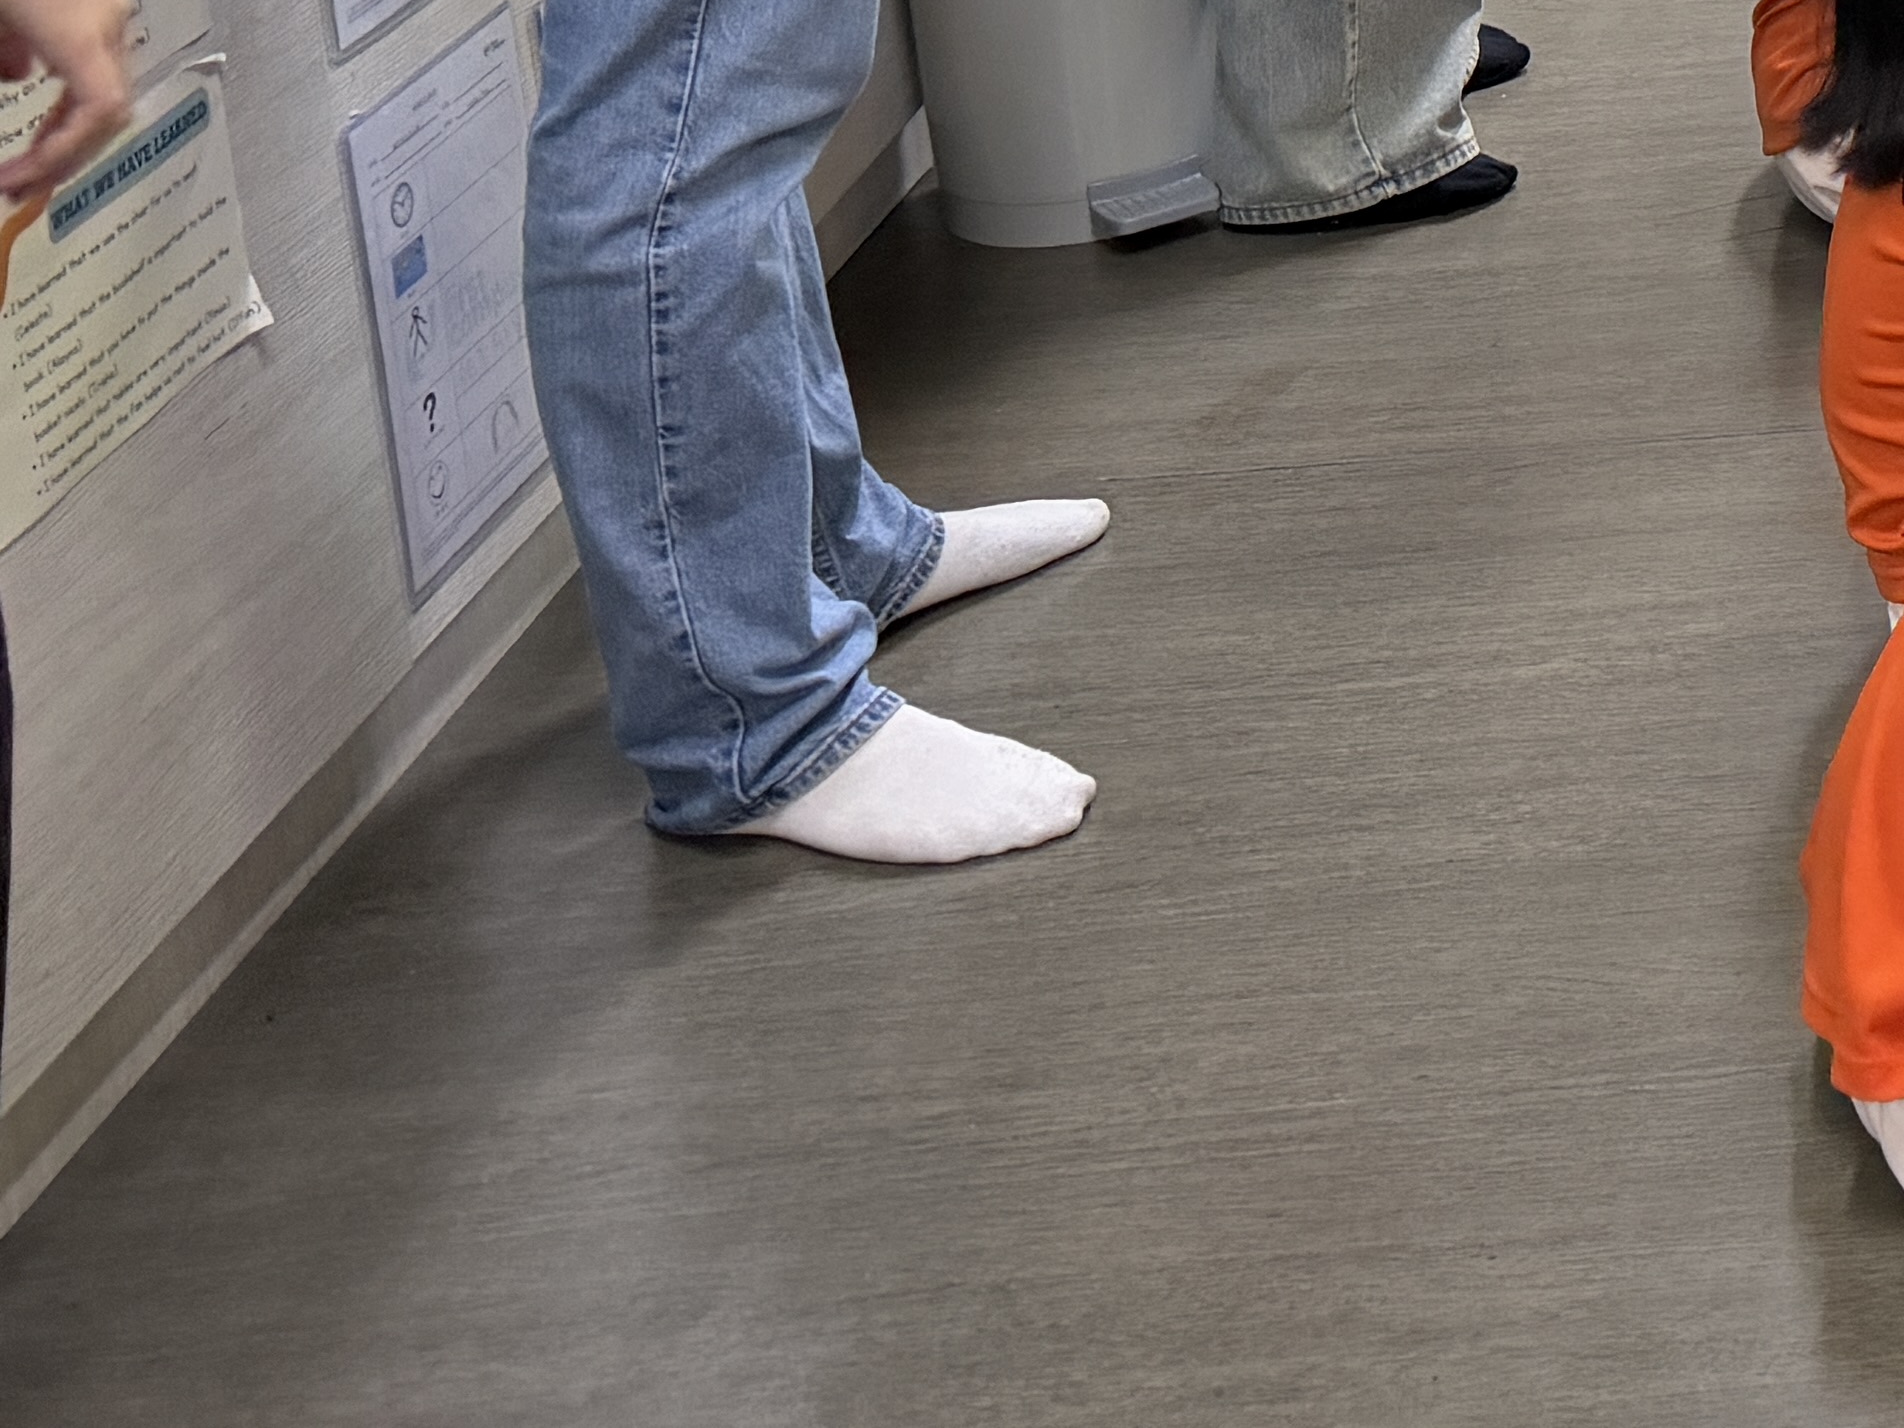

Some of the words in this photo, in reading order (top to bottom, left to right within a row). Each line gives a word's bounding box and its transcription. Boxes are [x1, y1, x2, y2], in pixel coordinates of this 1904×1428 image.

[51, 188, 91, 231] WHAT
[93, 168, 115, 200] WE
[117, 143, 153, 185] HAVE
[153, 98, 207, 155] LEARNED
